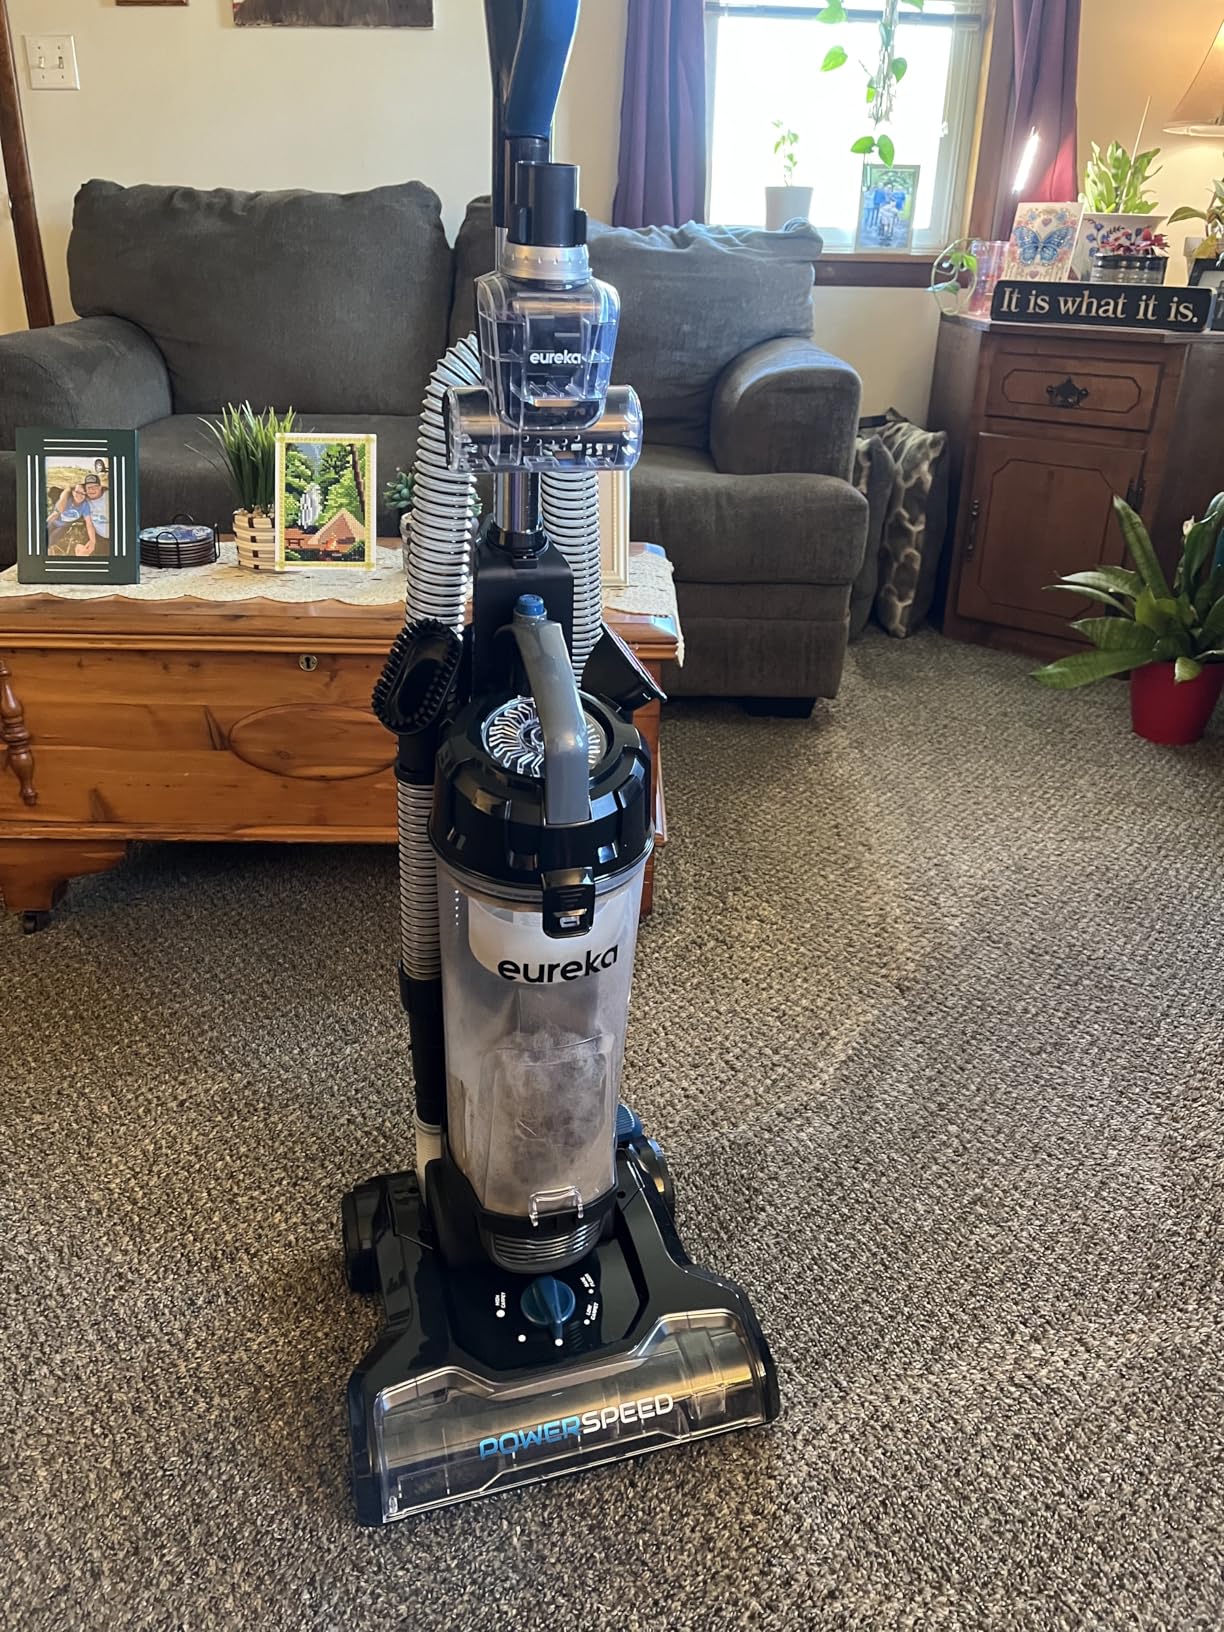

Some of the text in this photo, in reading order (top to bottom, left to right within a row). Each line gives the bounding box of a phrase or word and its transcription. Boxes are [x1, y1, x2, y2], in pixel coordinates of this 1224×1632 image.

[1000, 287, 1199, 324] It is what it is.
[529, 349, 582, 365] eureka
[497, 944, 619, 983] eureka
[591, 1302, 599, 1320] CARPET
[479, 1393, 674, 1461] POWERSPEED
